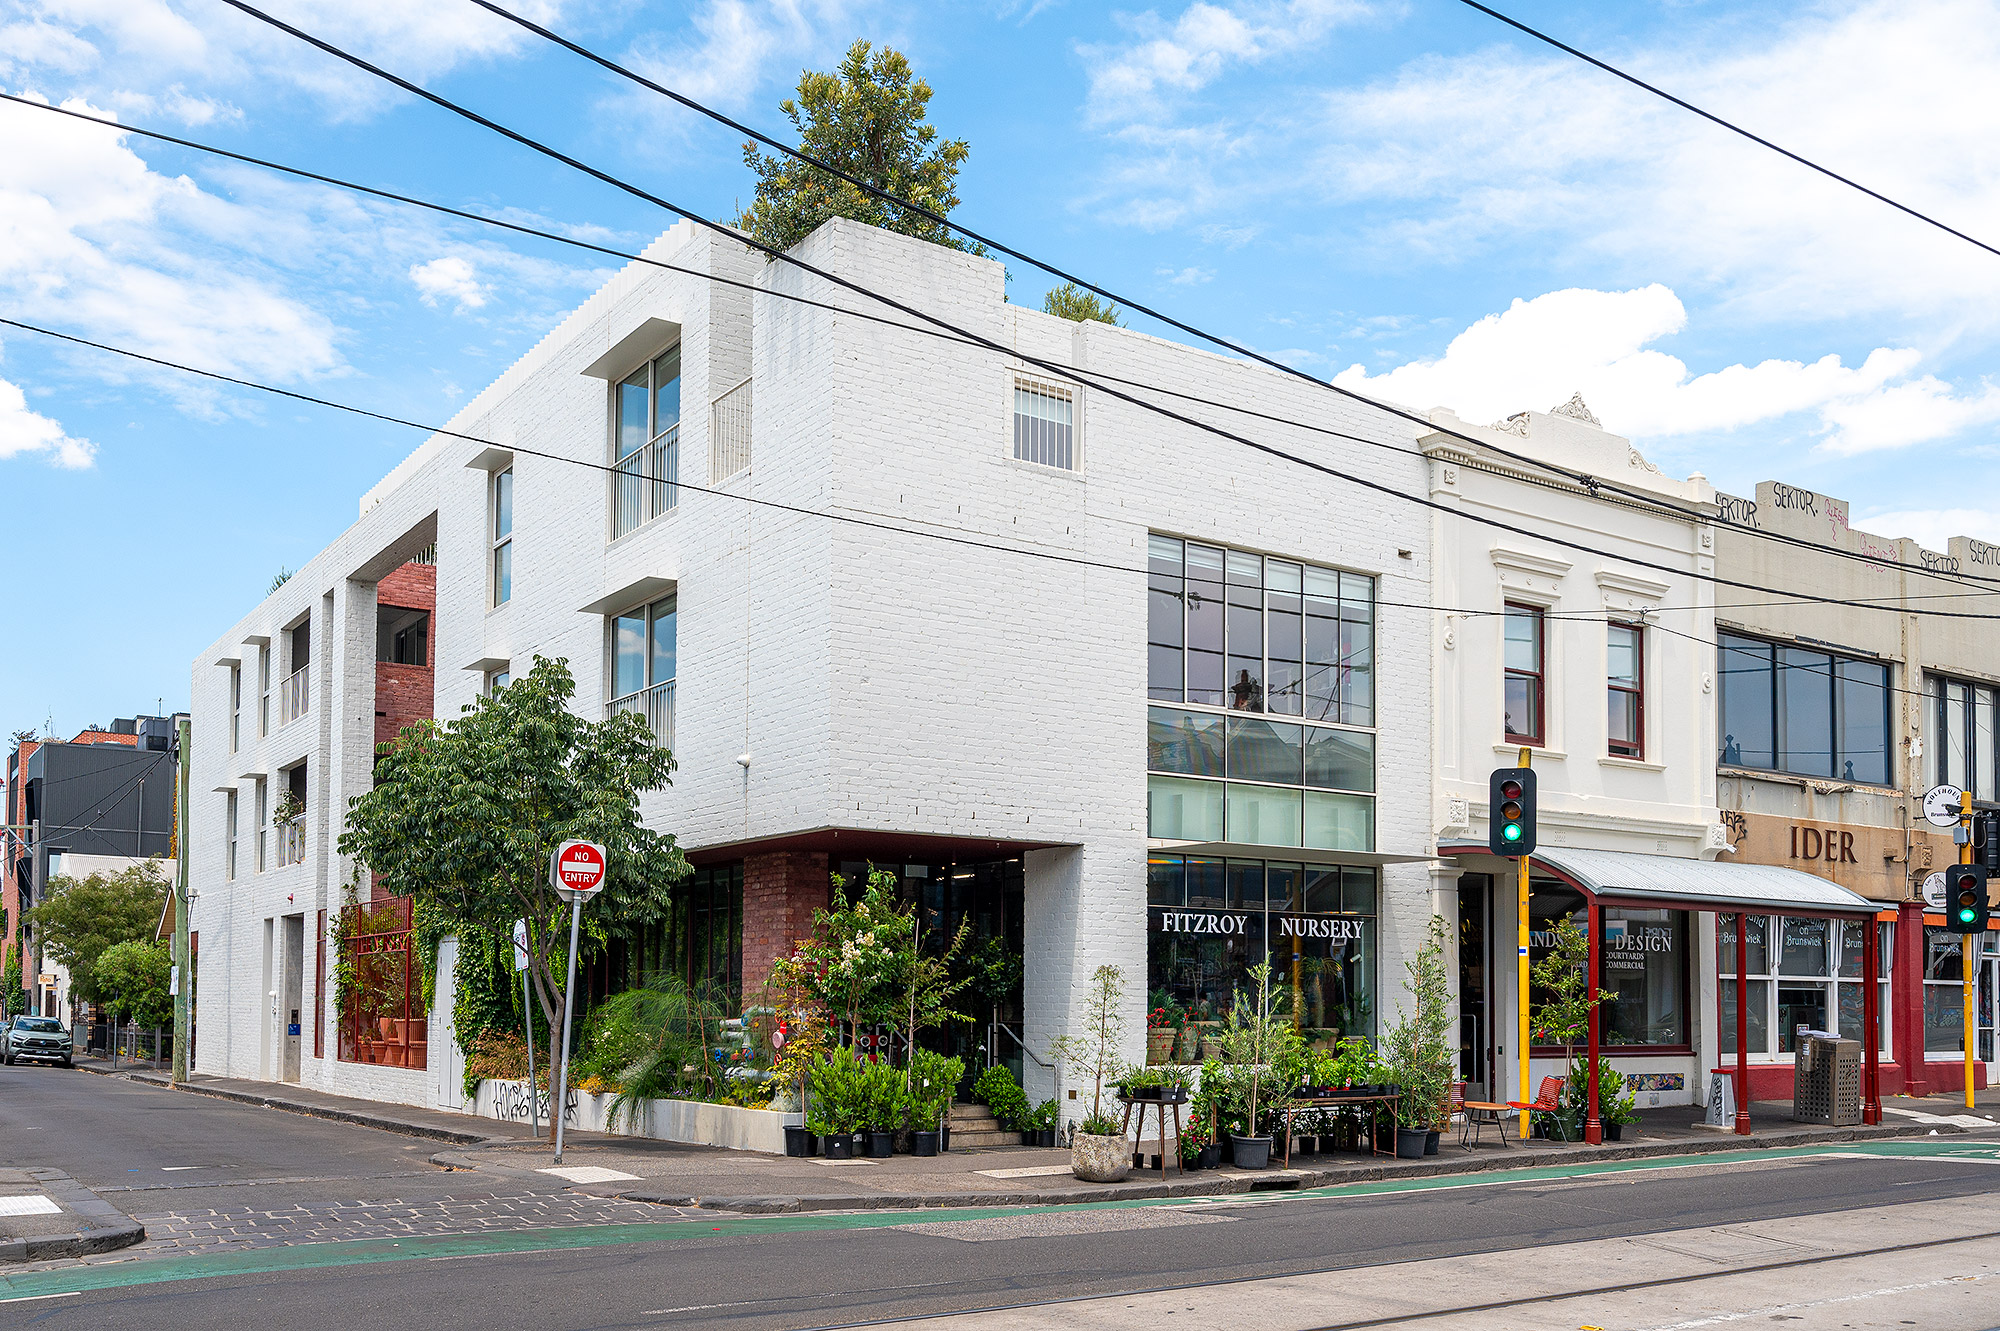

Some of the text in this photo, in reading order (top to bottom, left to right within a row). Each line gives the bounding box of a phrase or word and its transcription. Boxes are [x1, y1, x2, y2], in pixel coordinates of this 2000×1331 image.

[1789, 825, 1859, 864] IDER
[574, 851, 590, 862] NO
[564, 872, 597, 883] ENTRY
[1161, 912, 1364, 939] FITZROY NURSERY
[1799, 926, 1809, 936] on
[1615, 934, 1673, 952] DESIGN
[1723, 931, 1761, 944] Bruwick
[1786, 935, 1822, 947] Brunswick
